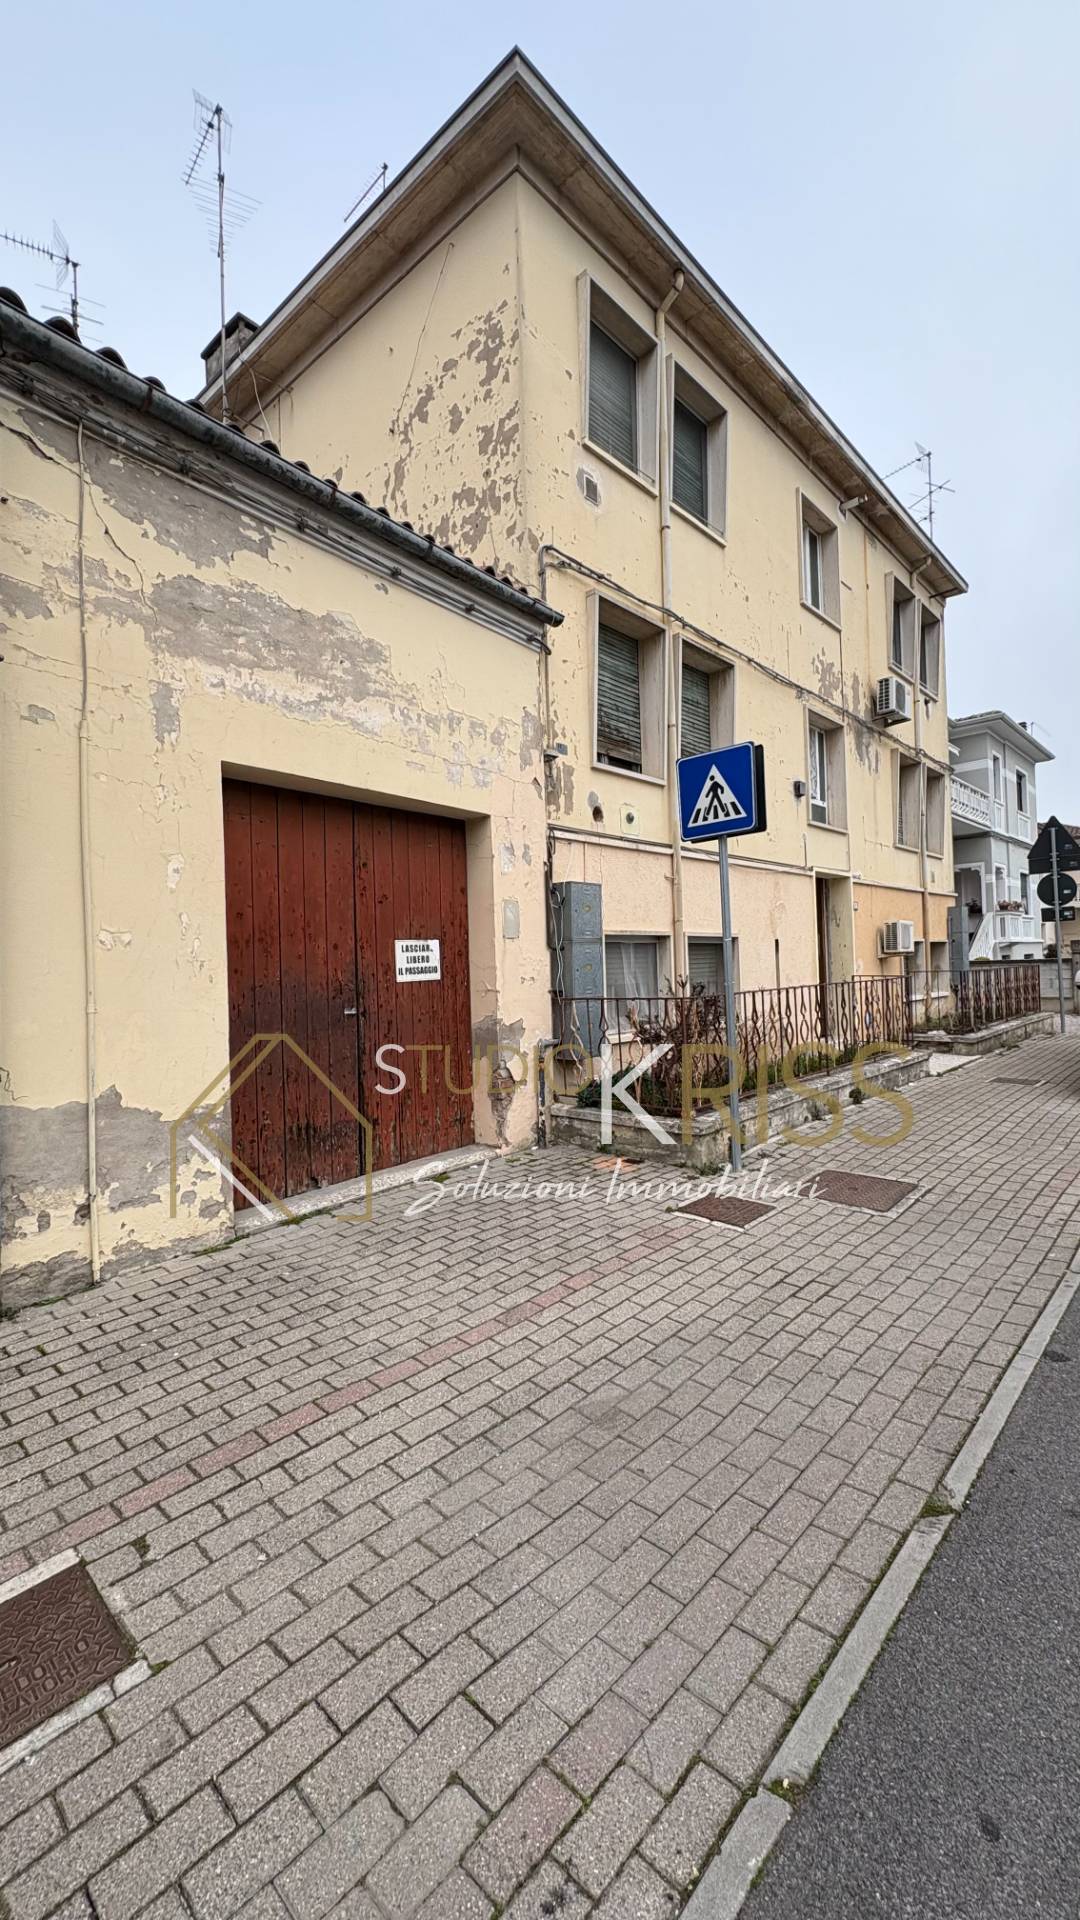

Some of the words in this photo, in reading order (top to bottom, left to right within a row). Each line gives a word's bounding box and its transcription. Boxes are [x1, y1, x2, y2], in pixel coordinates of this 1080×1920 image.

[406, 955, 430, 964] LIBERO
[398, 967, 404, 976] IL
[405, 965, 438, 975] PASSAGGIO
